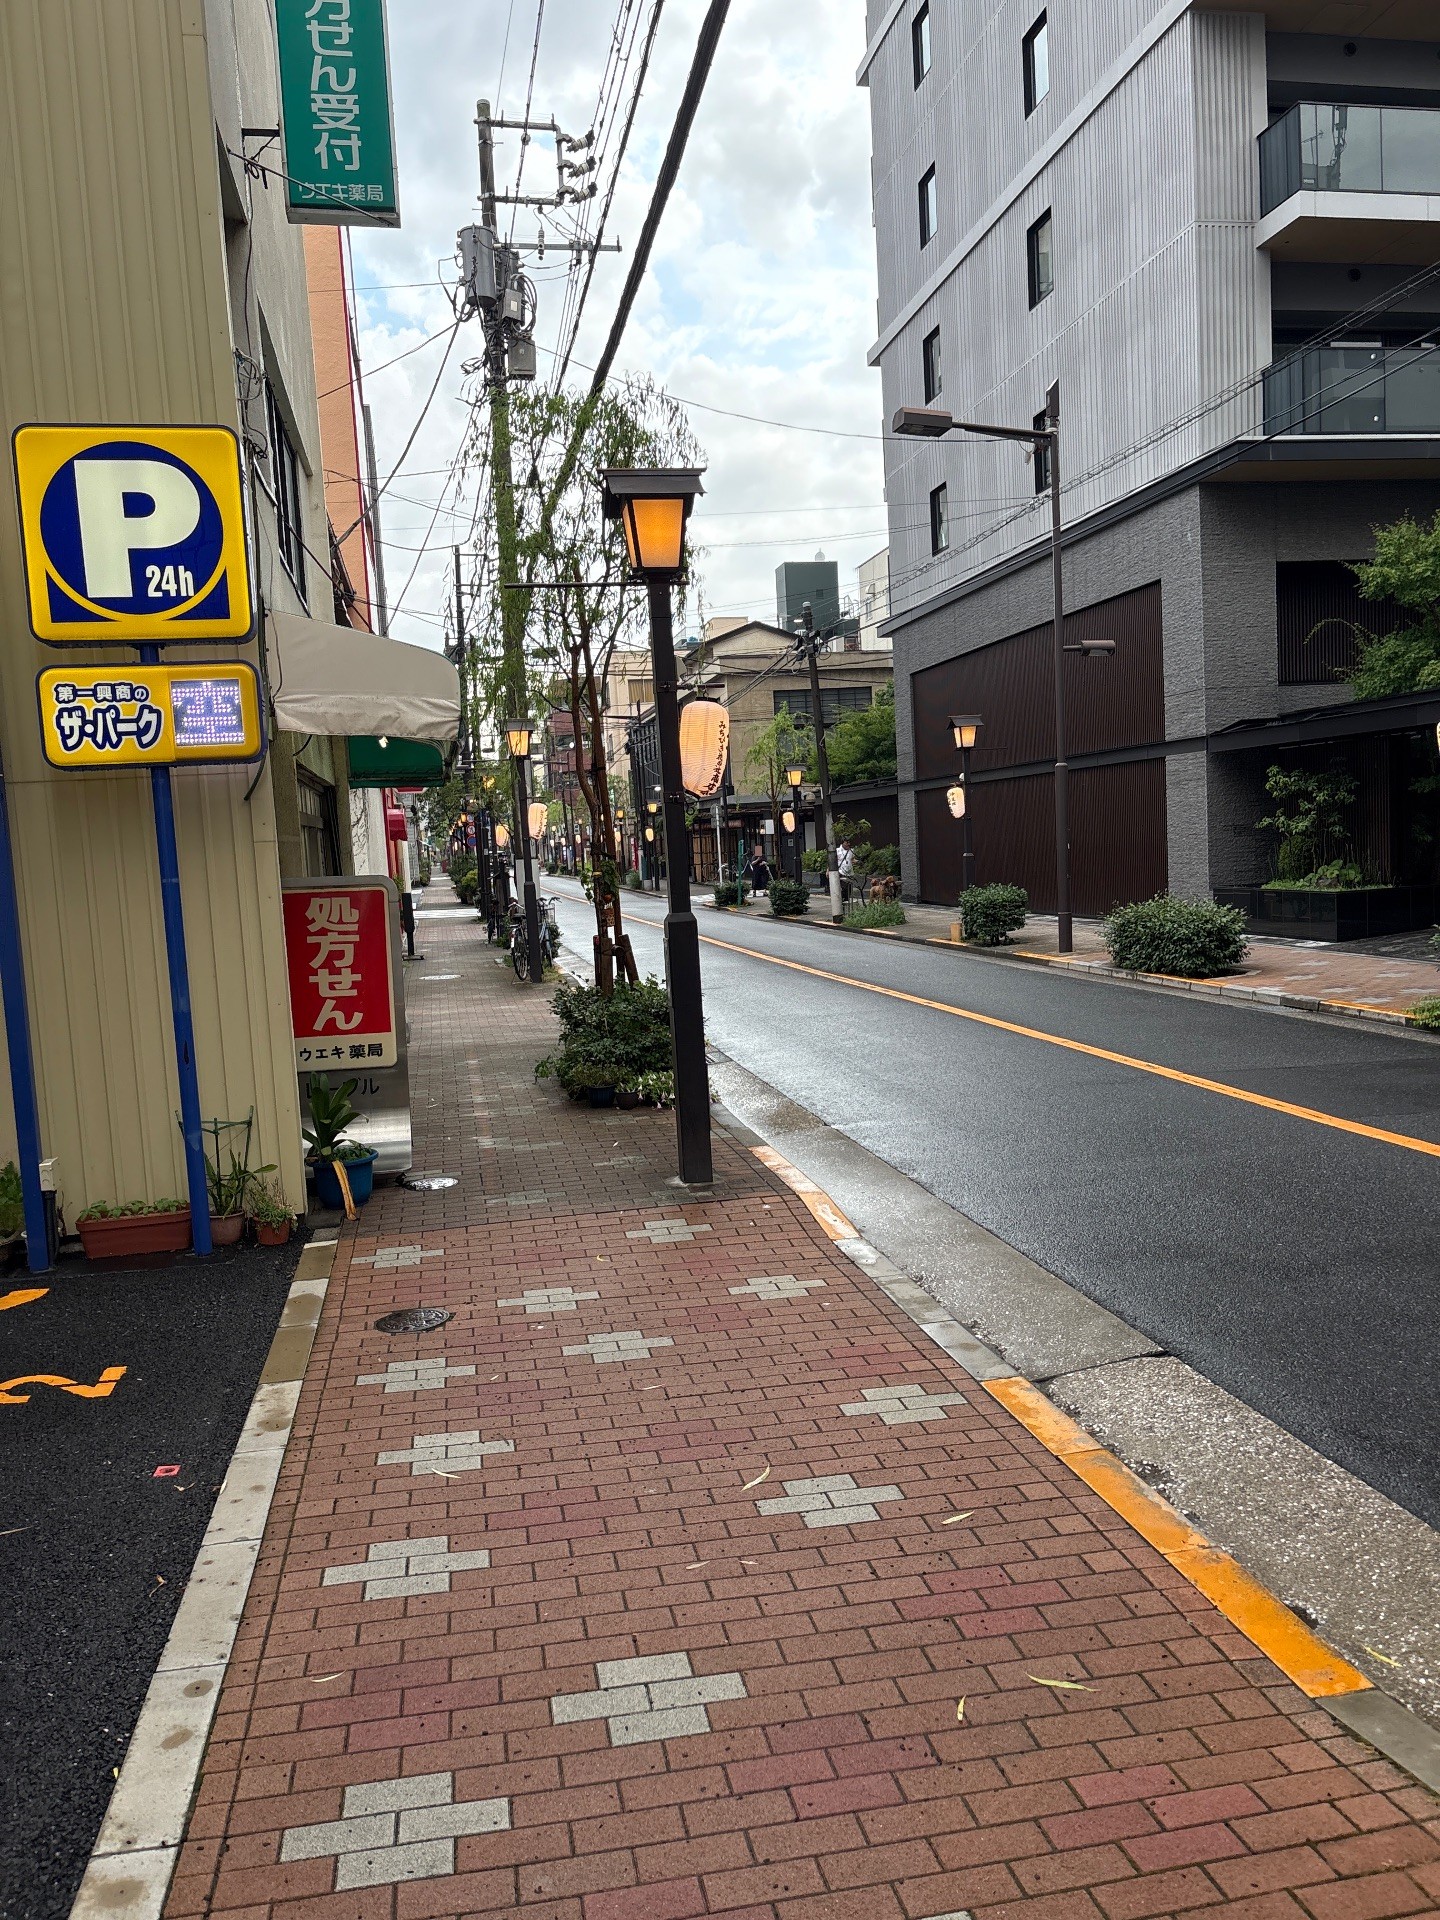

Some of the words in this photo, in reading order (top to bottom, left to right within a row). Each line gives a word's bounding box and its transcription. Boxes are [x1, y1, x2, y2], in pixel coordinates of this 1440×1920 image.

[299, 182, 384, 202] ウエキ薬局
[74, 459, 201, 598] P
[145, 565, 195, 597] 24h
[57, 683, 148, 703] 第一興商の
[59, 707, 161, 750] ザ・パーク
[172, 681, 245, 744] 空
[305, 896, 364, 1032] 処方せん
[299, 1043, 384, 1062] ウエキ薬局
